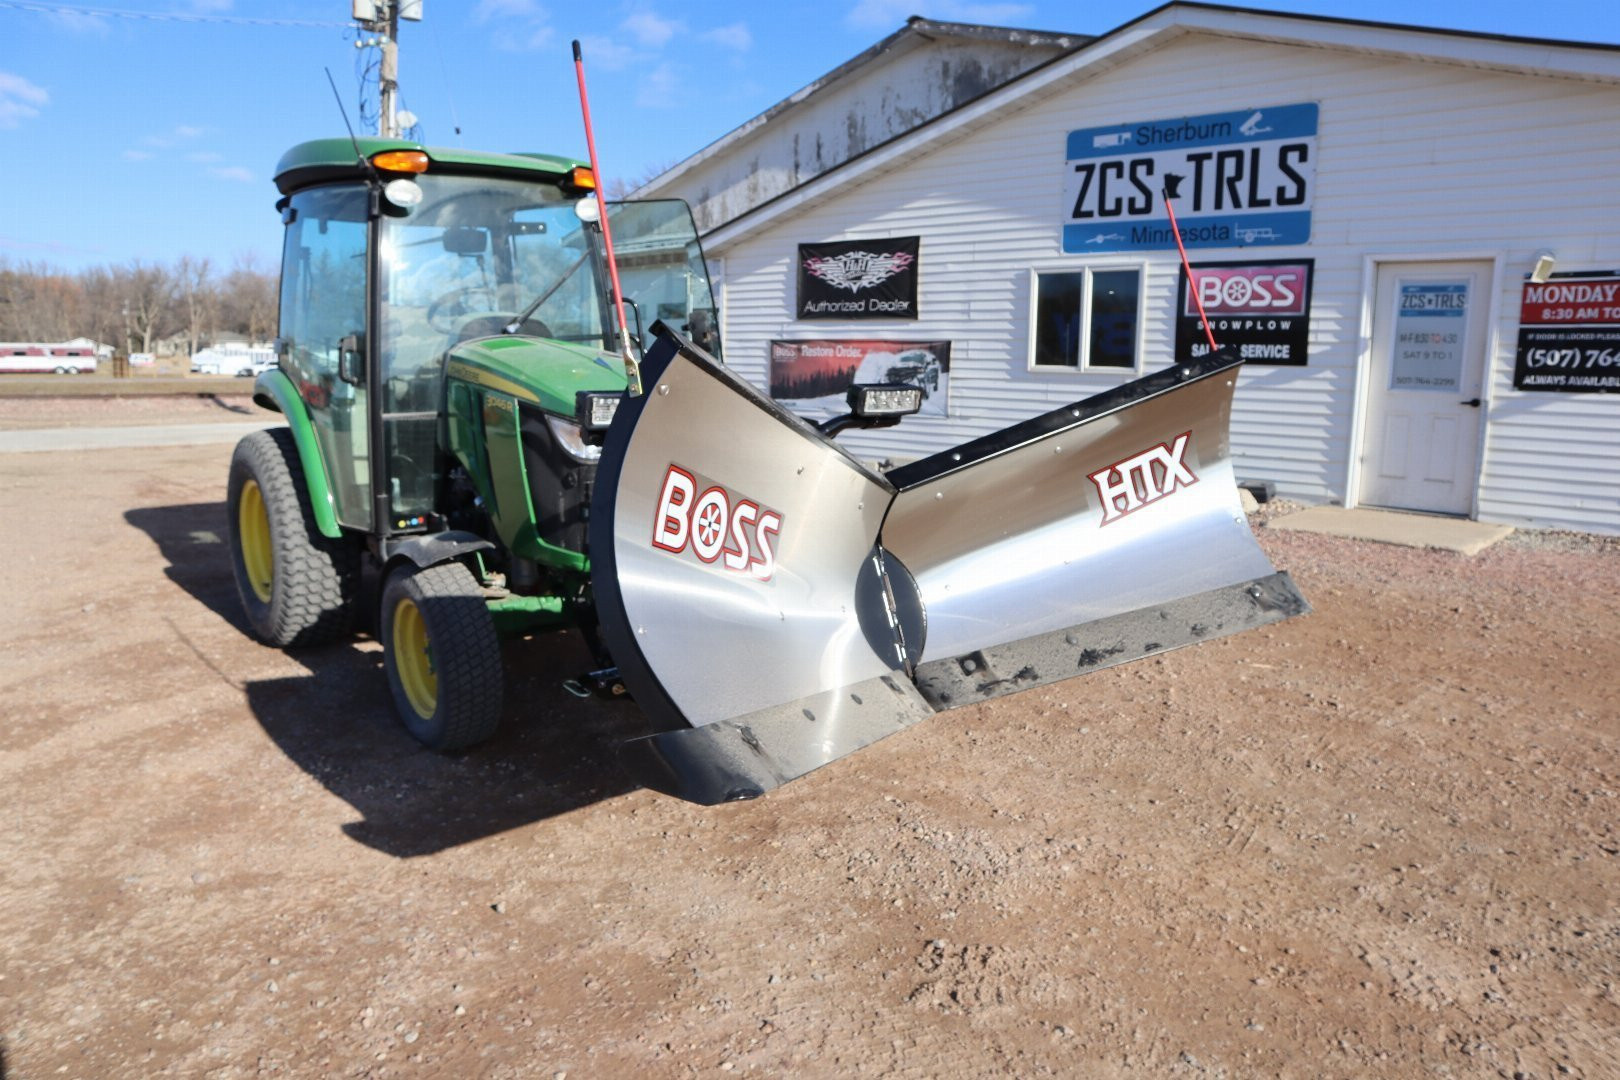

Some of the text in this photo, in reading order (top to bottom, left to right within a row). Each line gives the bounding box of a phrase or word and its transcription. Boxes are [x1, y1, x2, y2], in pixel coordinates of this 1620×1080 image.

[1136, 121, 1231, 146] Sherburn
[1072, 143, 1309, 219] ZCS TRLS
[1131, 223, 1230, 245] Minnesota
[1198, 274, 1297, 308] BOSS
[1401, 293, 1466, 308] ZCS TRLS
[1526, 285, 1619, 303] MONDAY
[804, 299, 911, 312] Authorized Dealer
[1575, 307, 1599, 319] AM
[1197, 320, 1292, 330] SNOWPLOW
[1240, 344, 1290, 359] SERVICE
[1526, 347, 1581, 369] (507)
[1523, 375, 1566, 386] ALWAYS
[1086, 430, 1200, 528] HTX
[652, 463, 783, 582] BOSS
